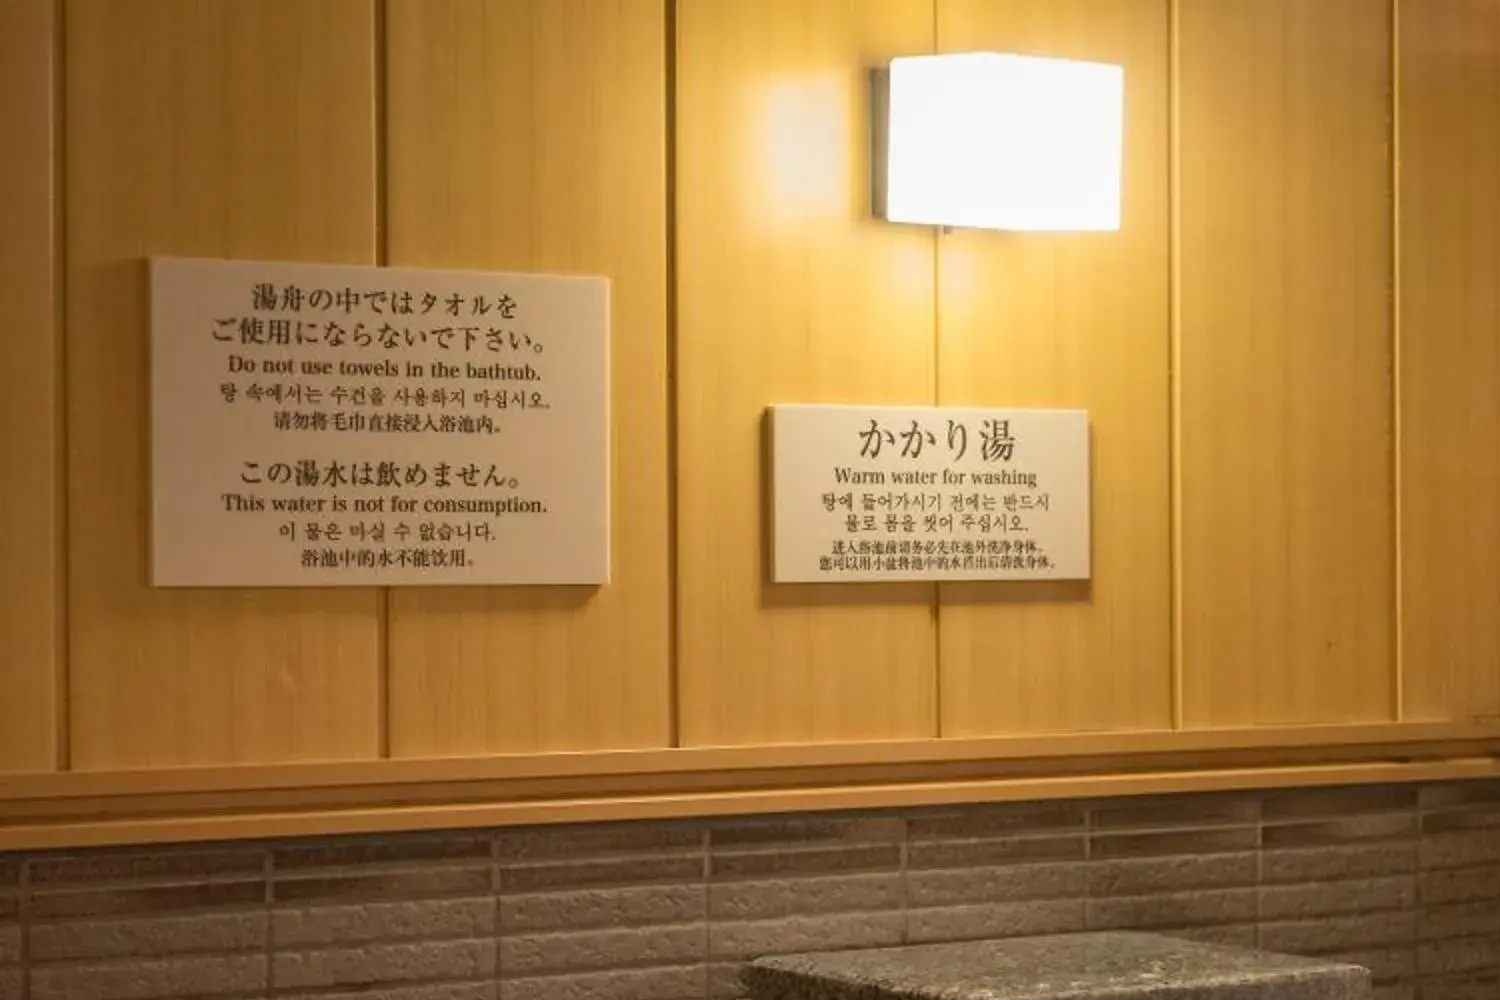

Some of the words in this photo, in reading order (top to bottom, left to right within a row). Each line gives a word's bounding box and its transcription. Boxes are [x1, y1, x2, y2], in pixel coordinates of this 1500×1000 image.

[251, 282, 518, 320] 湯舟の中ではタオルを
[211, 317, 544, 355] ご使用にならないで下さい。
[227, 354, 256, 375] Do
[261, 355, 294, 376] not
[300, 358, 333, 377] use
[338, 359, 399, 379] towels
[405, 360, 424, 379] in
[430, 360, 460, 381] the
[465, 361, 543, 383] bathtub.
[219, 382, 239, 403] 탕
[245, 383, 323, 406] 속에서는
[329, 385, 386, 407] 수건을
[391, 387, 467, 408] 사용하지
[858, 418, 1018, 463] かかり湯
[240, 459, 520, 491] この湯水は飲めません。
[834, 467, 886, 486] Warm
[891, 469, 938, 486] water
[943, 467, 966, 486] for
[971, 468, 1038, 489] washing
[221, 493, 265, 513] This
[271, 495, 326, 514] water
[331, 495, 349, 513] is
[354, 495, 386, 514] not
[390, 495, 417, 514] for
[423, 496, 549, 518] consumption.
[821, 491, 854, 512] 탕에
[861, 492, 942, 513] 들어가시기
[950, 492, 997, 512] 전에는
[1003, 492, 1051, 512] 반드시
[279, 522, 297, 543] 이
[394, 522, 411, 543] 수
[418, 521, 497, 544] 없습니다.
[924, 513, 955, 534] 씻어
[961, 513, 1029, 534] 주십시오.
[301, 548, 477, 569] 浴池中的水不能饮用。
